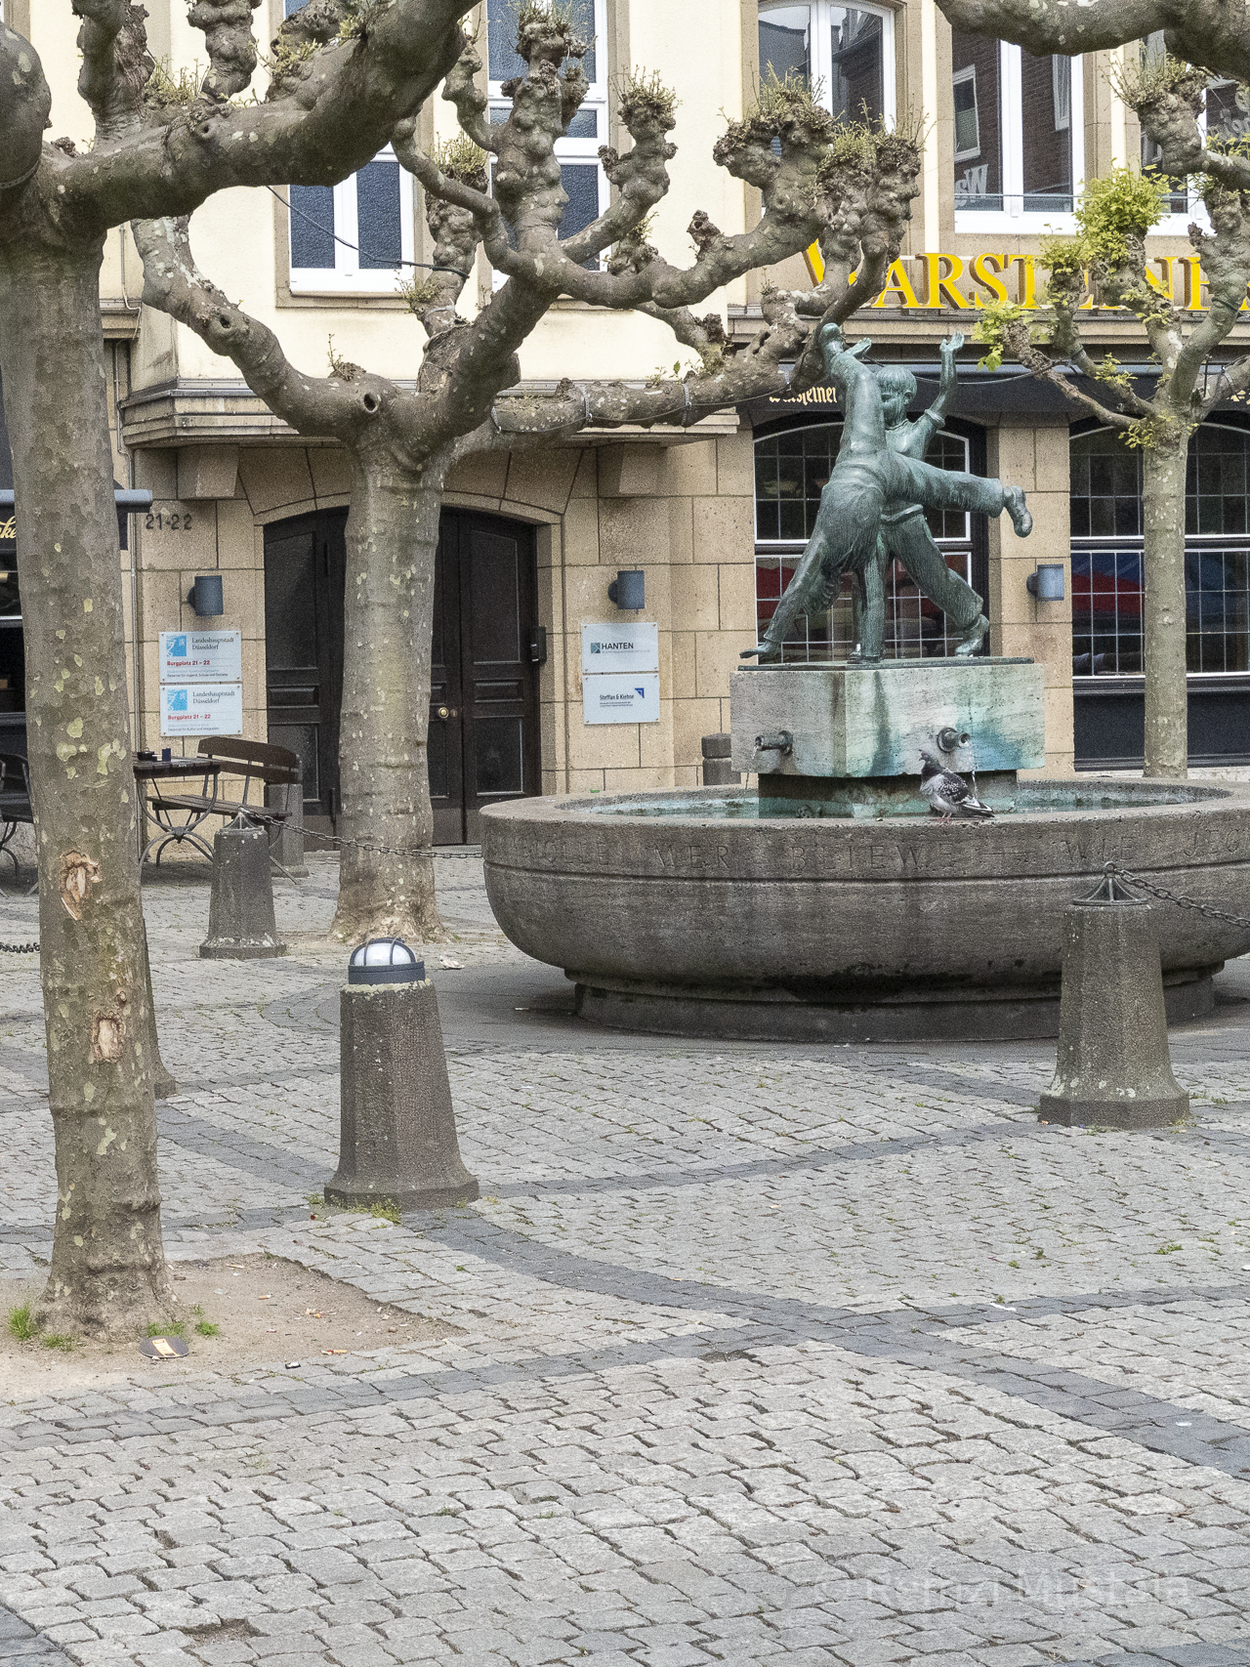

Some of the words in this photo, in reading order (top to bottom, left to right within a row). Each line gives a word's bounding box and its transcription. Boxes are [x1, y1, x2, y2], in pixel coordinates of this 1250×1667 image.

[145, 513, 193, 530] 21-22
[601, 642, 634, 650] HANTEN
[652, 844, 730, 869] WER
